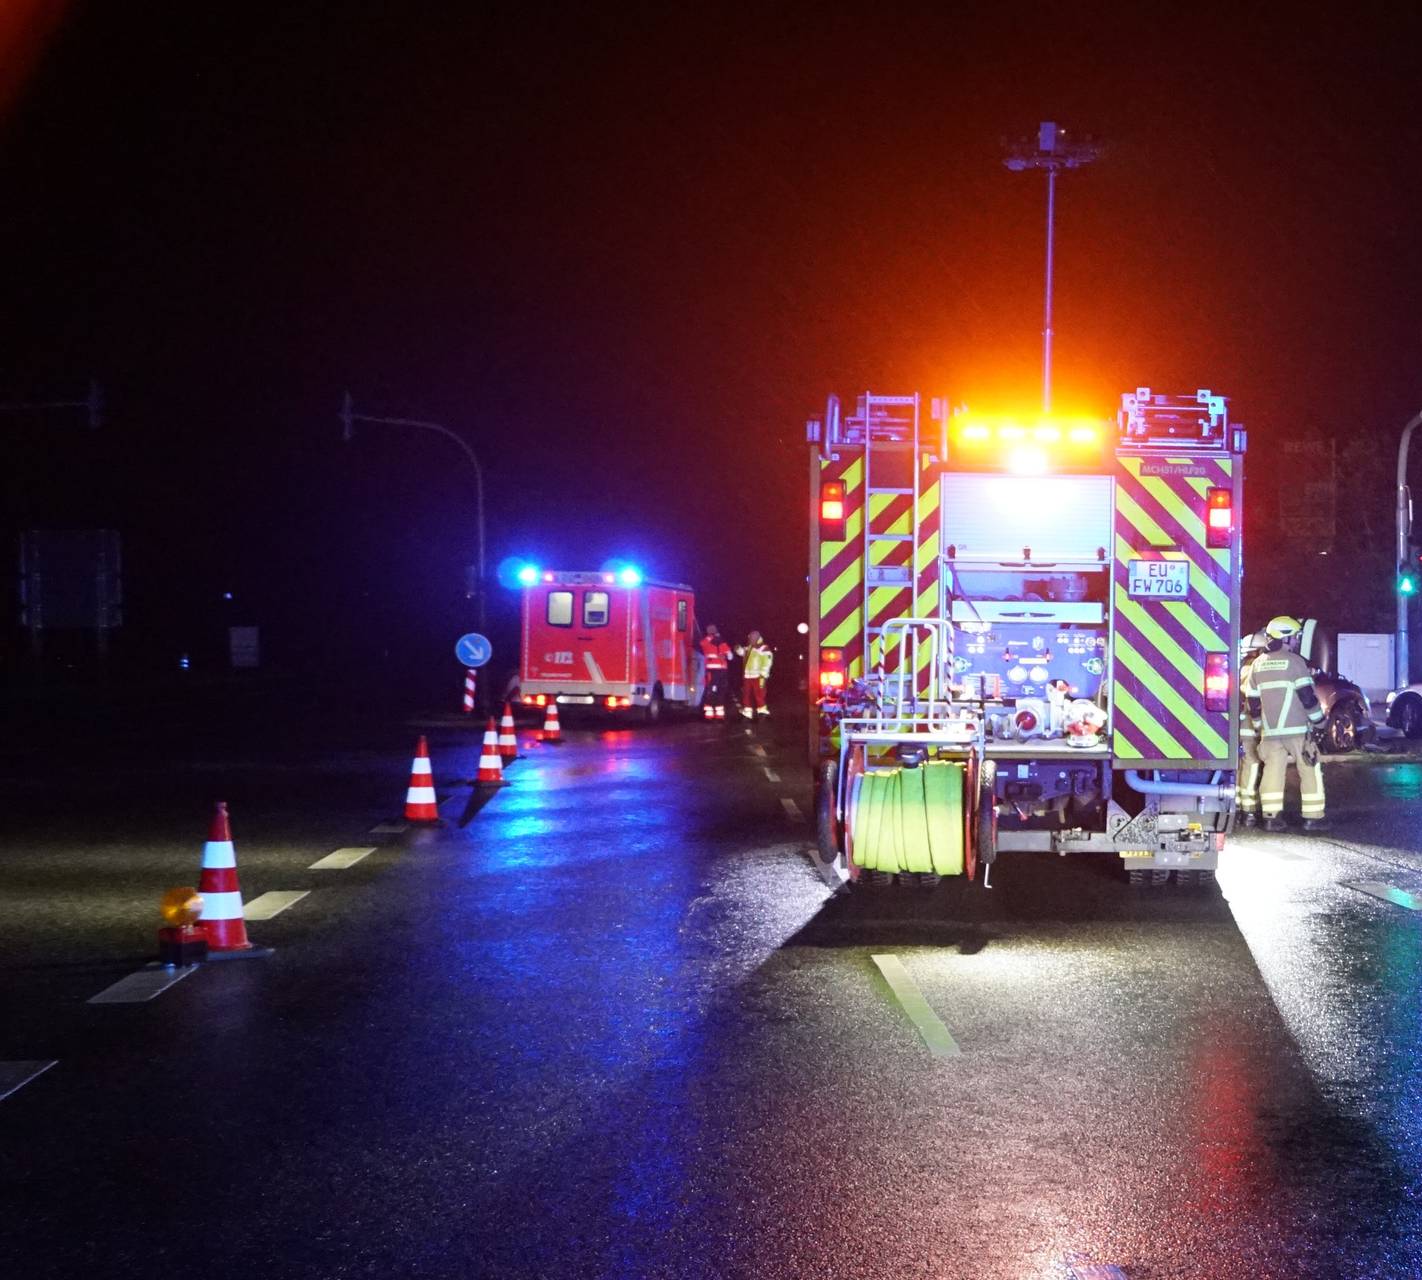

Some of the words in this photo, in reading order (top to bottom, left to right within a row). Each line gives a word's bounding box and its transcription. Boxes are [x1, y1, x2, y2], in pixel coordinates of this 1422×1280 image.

[1148, 563, 1168, 577] EU
[1133, 580, 1153, 593] FW
[1156, 579, 1183, 593] 706
